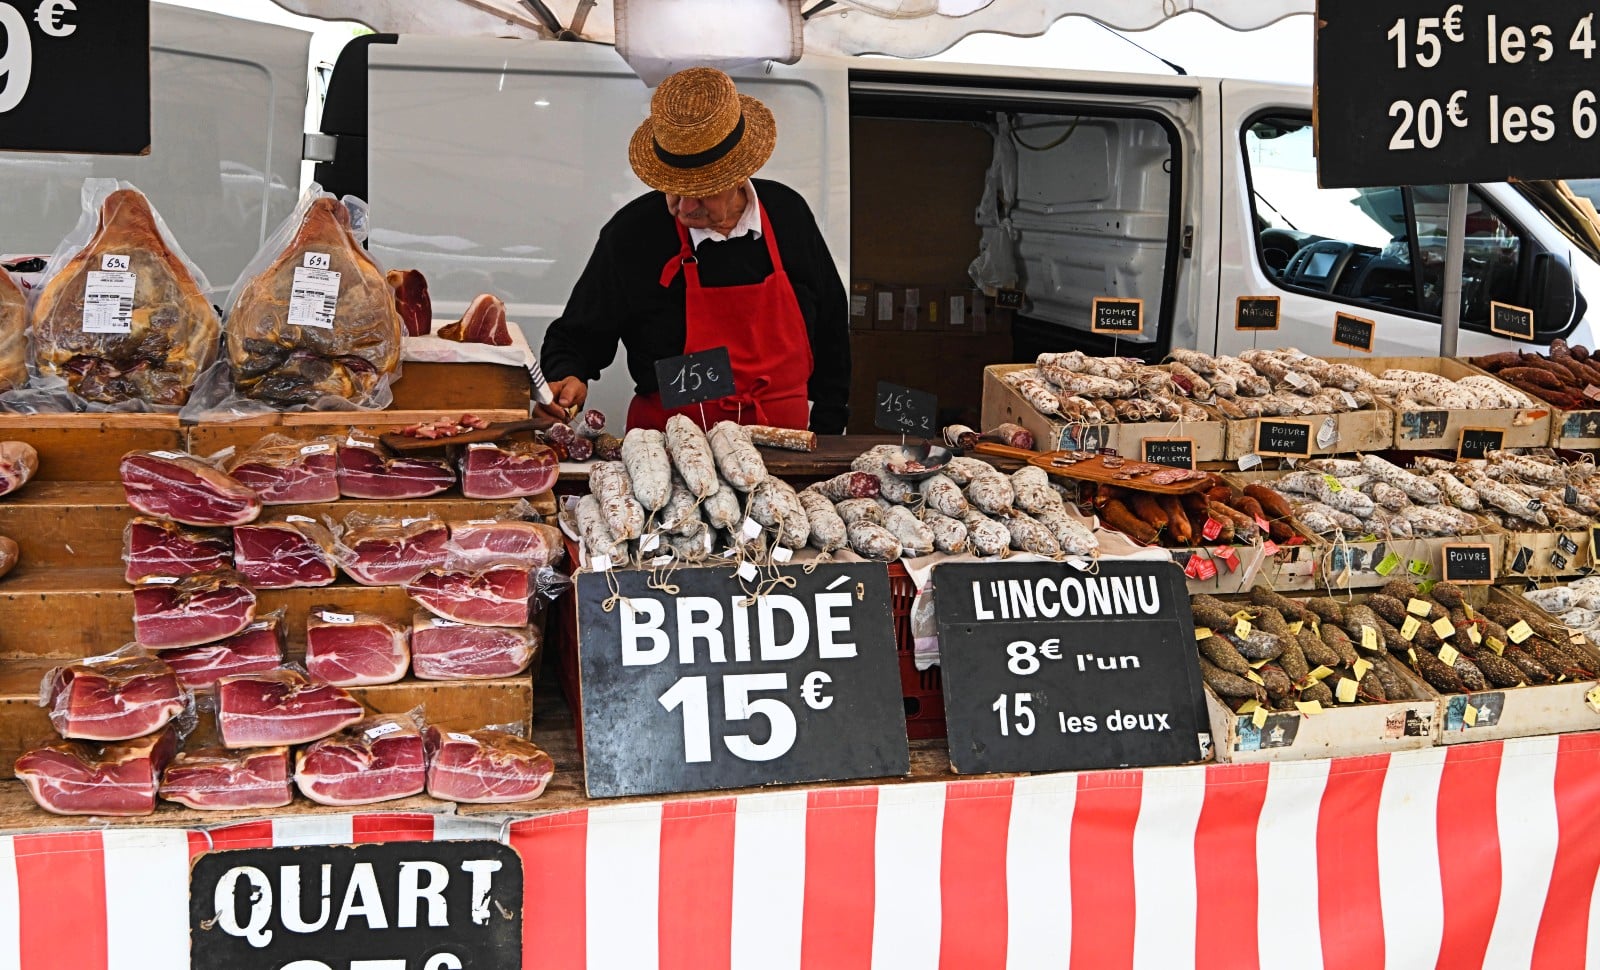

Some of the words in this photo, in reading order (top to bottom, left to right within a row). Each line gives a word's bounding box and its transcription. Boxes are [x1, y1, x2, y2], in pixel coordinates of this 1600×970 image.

[1387, 4, 1465, 69] 15€
[1487, 14, 1554, 65] les
[1569, 12, 1597, 59] 4
[1388, 89, 1469, 150] 20€
[1489, 94, 1556, 144] les
[1572, 89, 1598, 139] 6
[1099, 307, 1137, 317] TOMATE
[669, 361, 720, 393] 15€
[921, 415, 930, 430] 2
[1271, 426, 1306, 436] POIVRE
[1151, 444, 1189, 453] PIMENT
[1270, 438, 1296, 448] VERT
[1464, 440, 1495, 450] OLIVE
[1450, 551, 1487, 562] POIVRE
[972, 575, 1161, 620] L'INCONNU
[619, 575, 858, 667] BRIDÉ
[1006, 638, 1063, 676] 8€
[1076, 654, 1141, 672] l'un
[657, 670, 834, 763] 15€
[992, 692, 1037, 737] 15
[1058, 711, 1098, 733] les
[1106, 709, 1171, 732] deux
[214, 859, 503, 948] QUART
